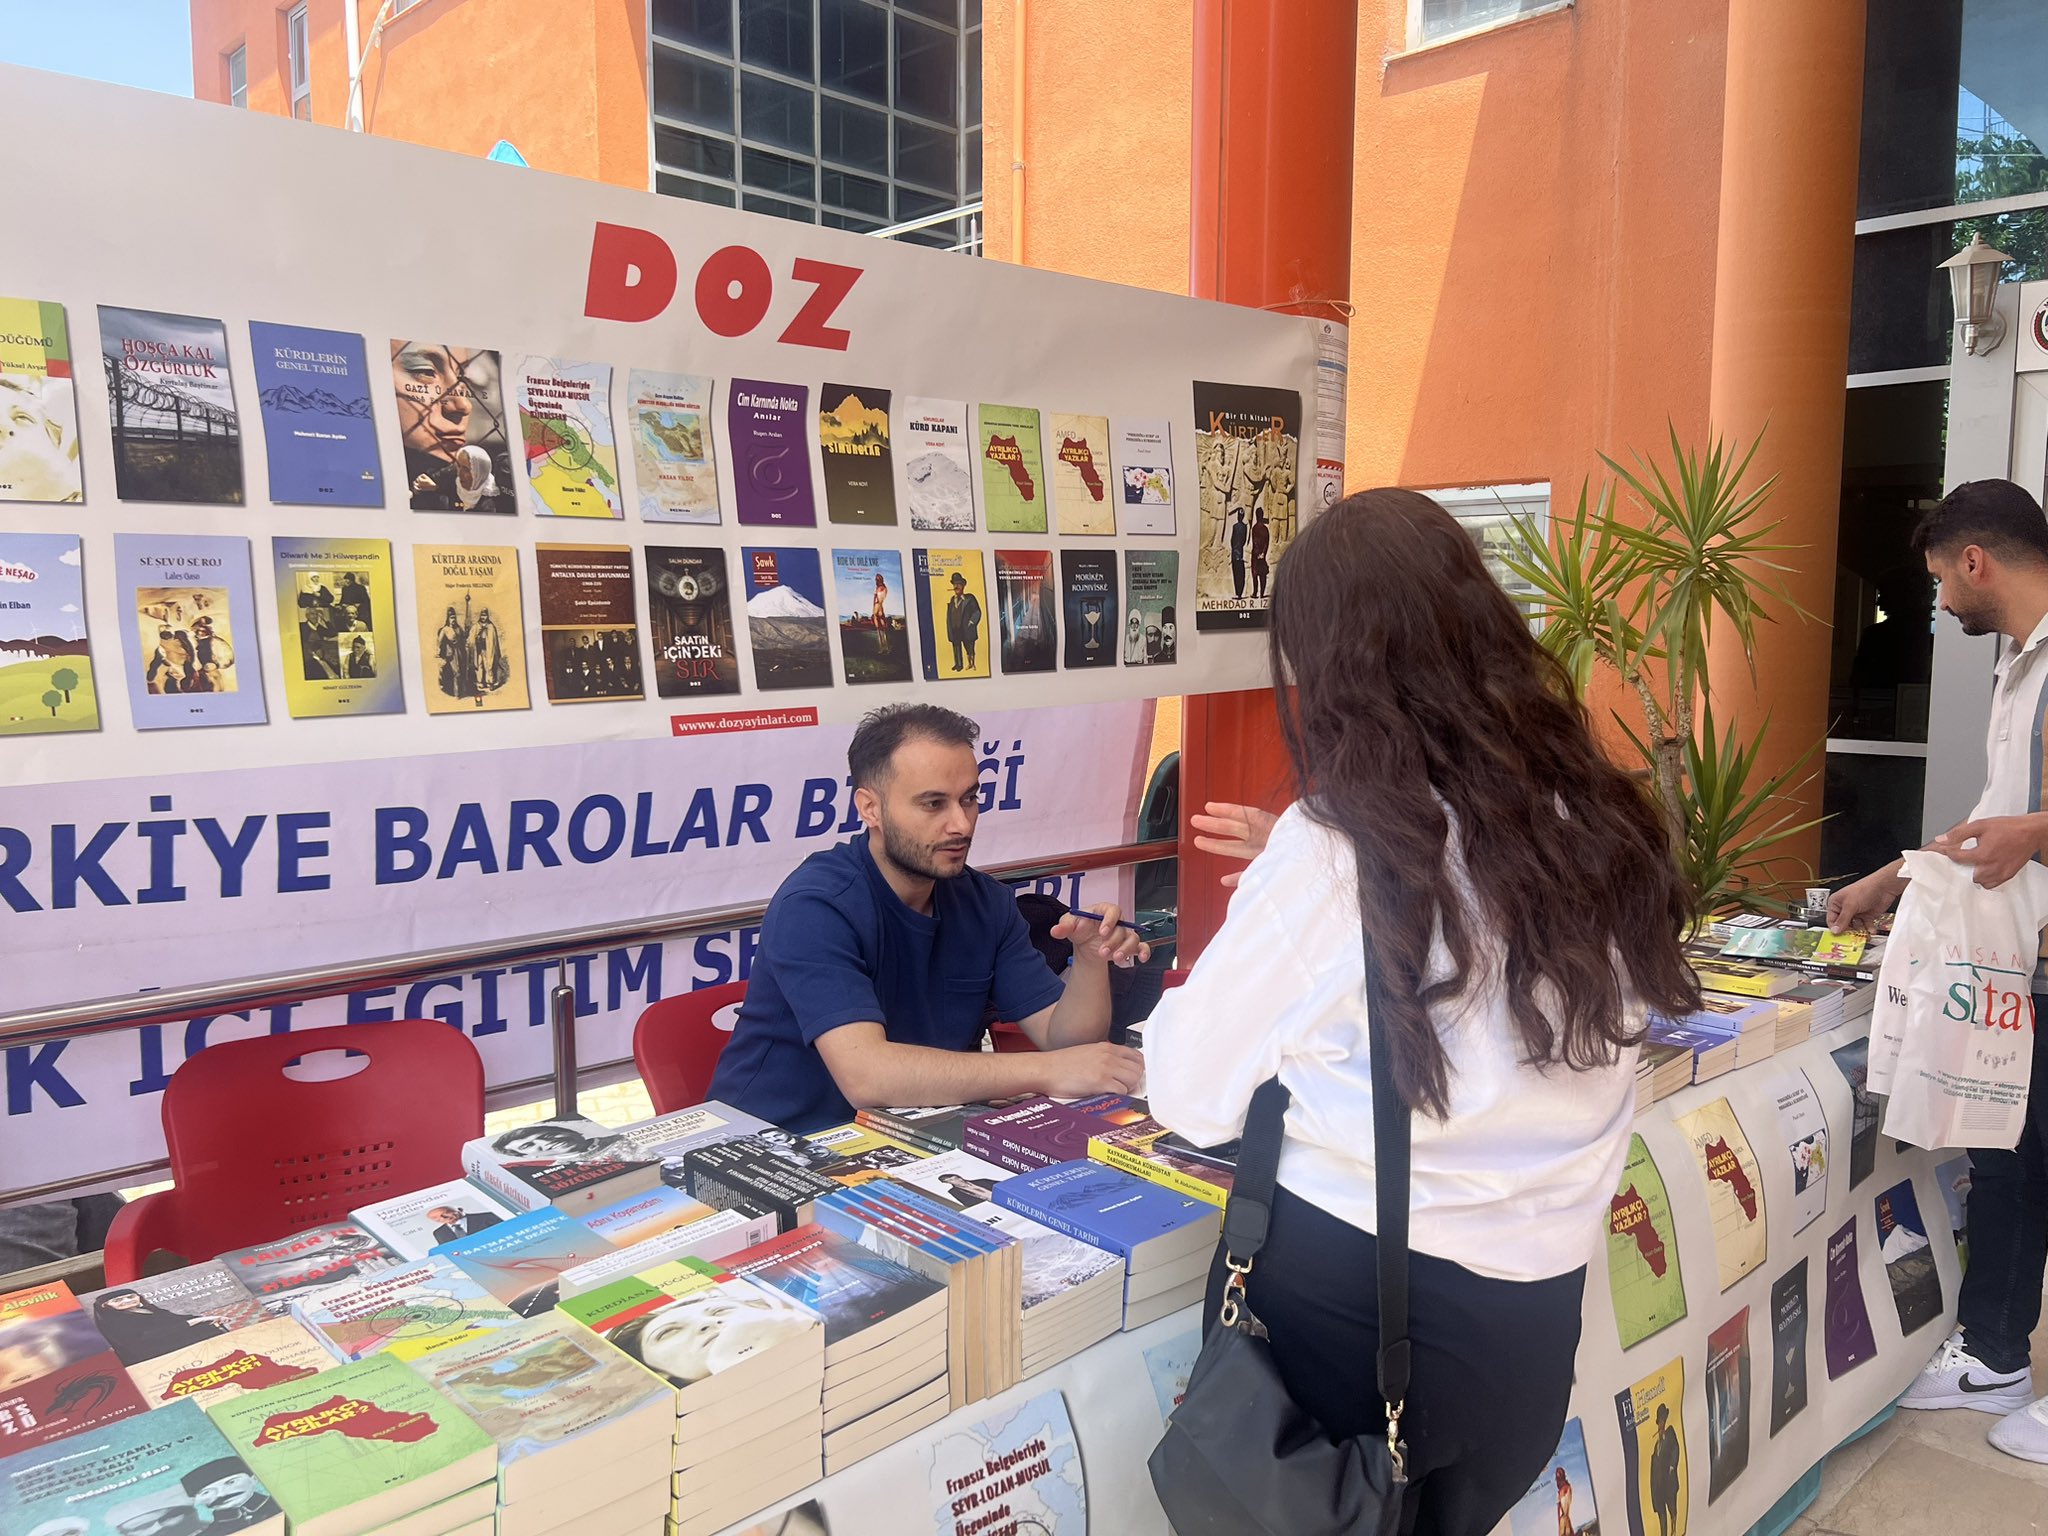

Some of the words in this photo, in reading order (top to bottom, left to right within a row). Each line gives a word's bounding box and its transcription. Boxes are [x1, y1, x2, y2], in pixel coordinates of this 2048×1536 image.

[584, 221, 865, 352] DOZ
[121, 338, 178, 359] HOŞÇA
[183, 344, 215, 361] KAL
[274, 347, 348, 365] KÜRDLERİN
[124, 350, 217, 379] ÖZGÜRLÜK
[276, 360, 312, 372] GENEL
[313, 364, 349, 376] TARİHİ
[737, 392, 750, 408] Cim
[779, 396, 798, 412] Nokta
[753, 412, 782, 422] Anılar
[931, 423, 958, 435] KAPANI
[1064, 453, 1089, 463] YAZILAR
[201, 558, 222, 567] ROJ
[310, 552, 323, 560] Me
[432, 553, 466, 565] KÜRTLER
[467, 554, 502, 566] ARASINDA
[755, 556, 775, 569] Şawk
[6, 567, 36, 580] NEŞAD
[443, 564, 468, 576] DOĞAL
[470, 566, 494, 578] YAŞAM
[9, 601, 31, 610] Elban
[1202, 599, 1247, 610] MEHRDAD
[1249, 600, 1258, 609] R.
[674, 635, 709, 645] SAATİN
[663, 645, 722, 662] İÇİNDEKİ
[675, 658, 721, 681] SIR
[374, 782, 773, 886] BAROLAR
[1708, 1150, 1734, 1170] AYRILIKÇI
[1712, 1159, 1737, 1178] YAZILAR
[1612, 1198, 1643, 1223] AYRILIKÇI
[1006, 1196, 1048, 1228] KÜRDLERİN
[1047, 1215, 1072, 1236] GENEL
[1072, 1225, 1100, 1246] TARİHİ
[1614, 1213, 1643, 1233] YAZILAR
[463, 1234, 515, 1256] BATMAN
[489, 1238, 523, 1254] UZAK
[525, 1224, 560, 1245] DEĞİL
[2, 1291, 60, 1313] Alevilik
[171, 1354, 258, 1391] AYRILIKÇI
[264, 1400, 360, 1437] AYRILIKÇI
[146, 1442, 173, 1457] BEY
[176, 1435, 194, 1444] ve
[945, 1465, 986, 1495] Fransız
[985, 1437, 1048, 1478] Belgeleriyle
[950, 1458, 1054, 1518] SEVR-LOZAN-MUSUL
